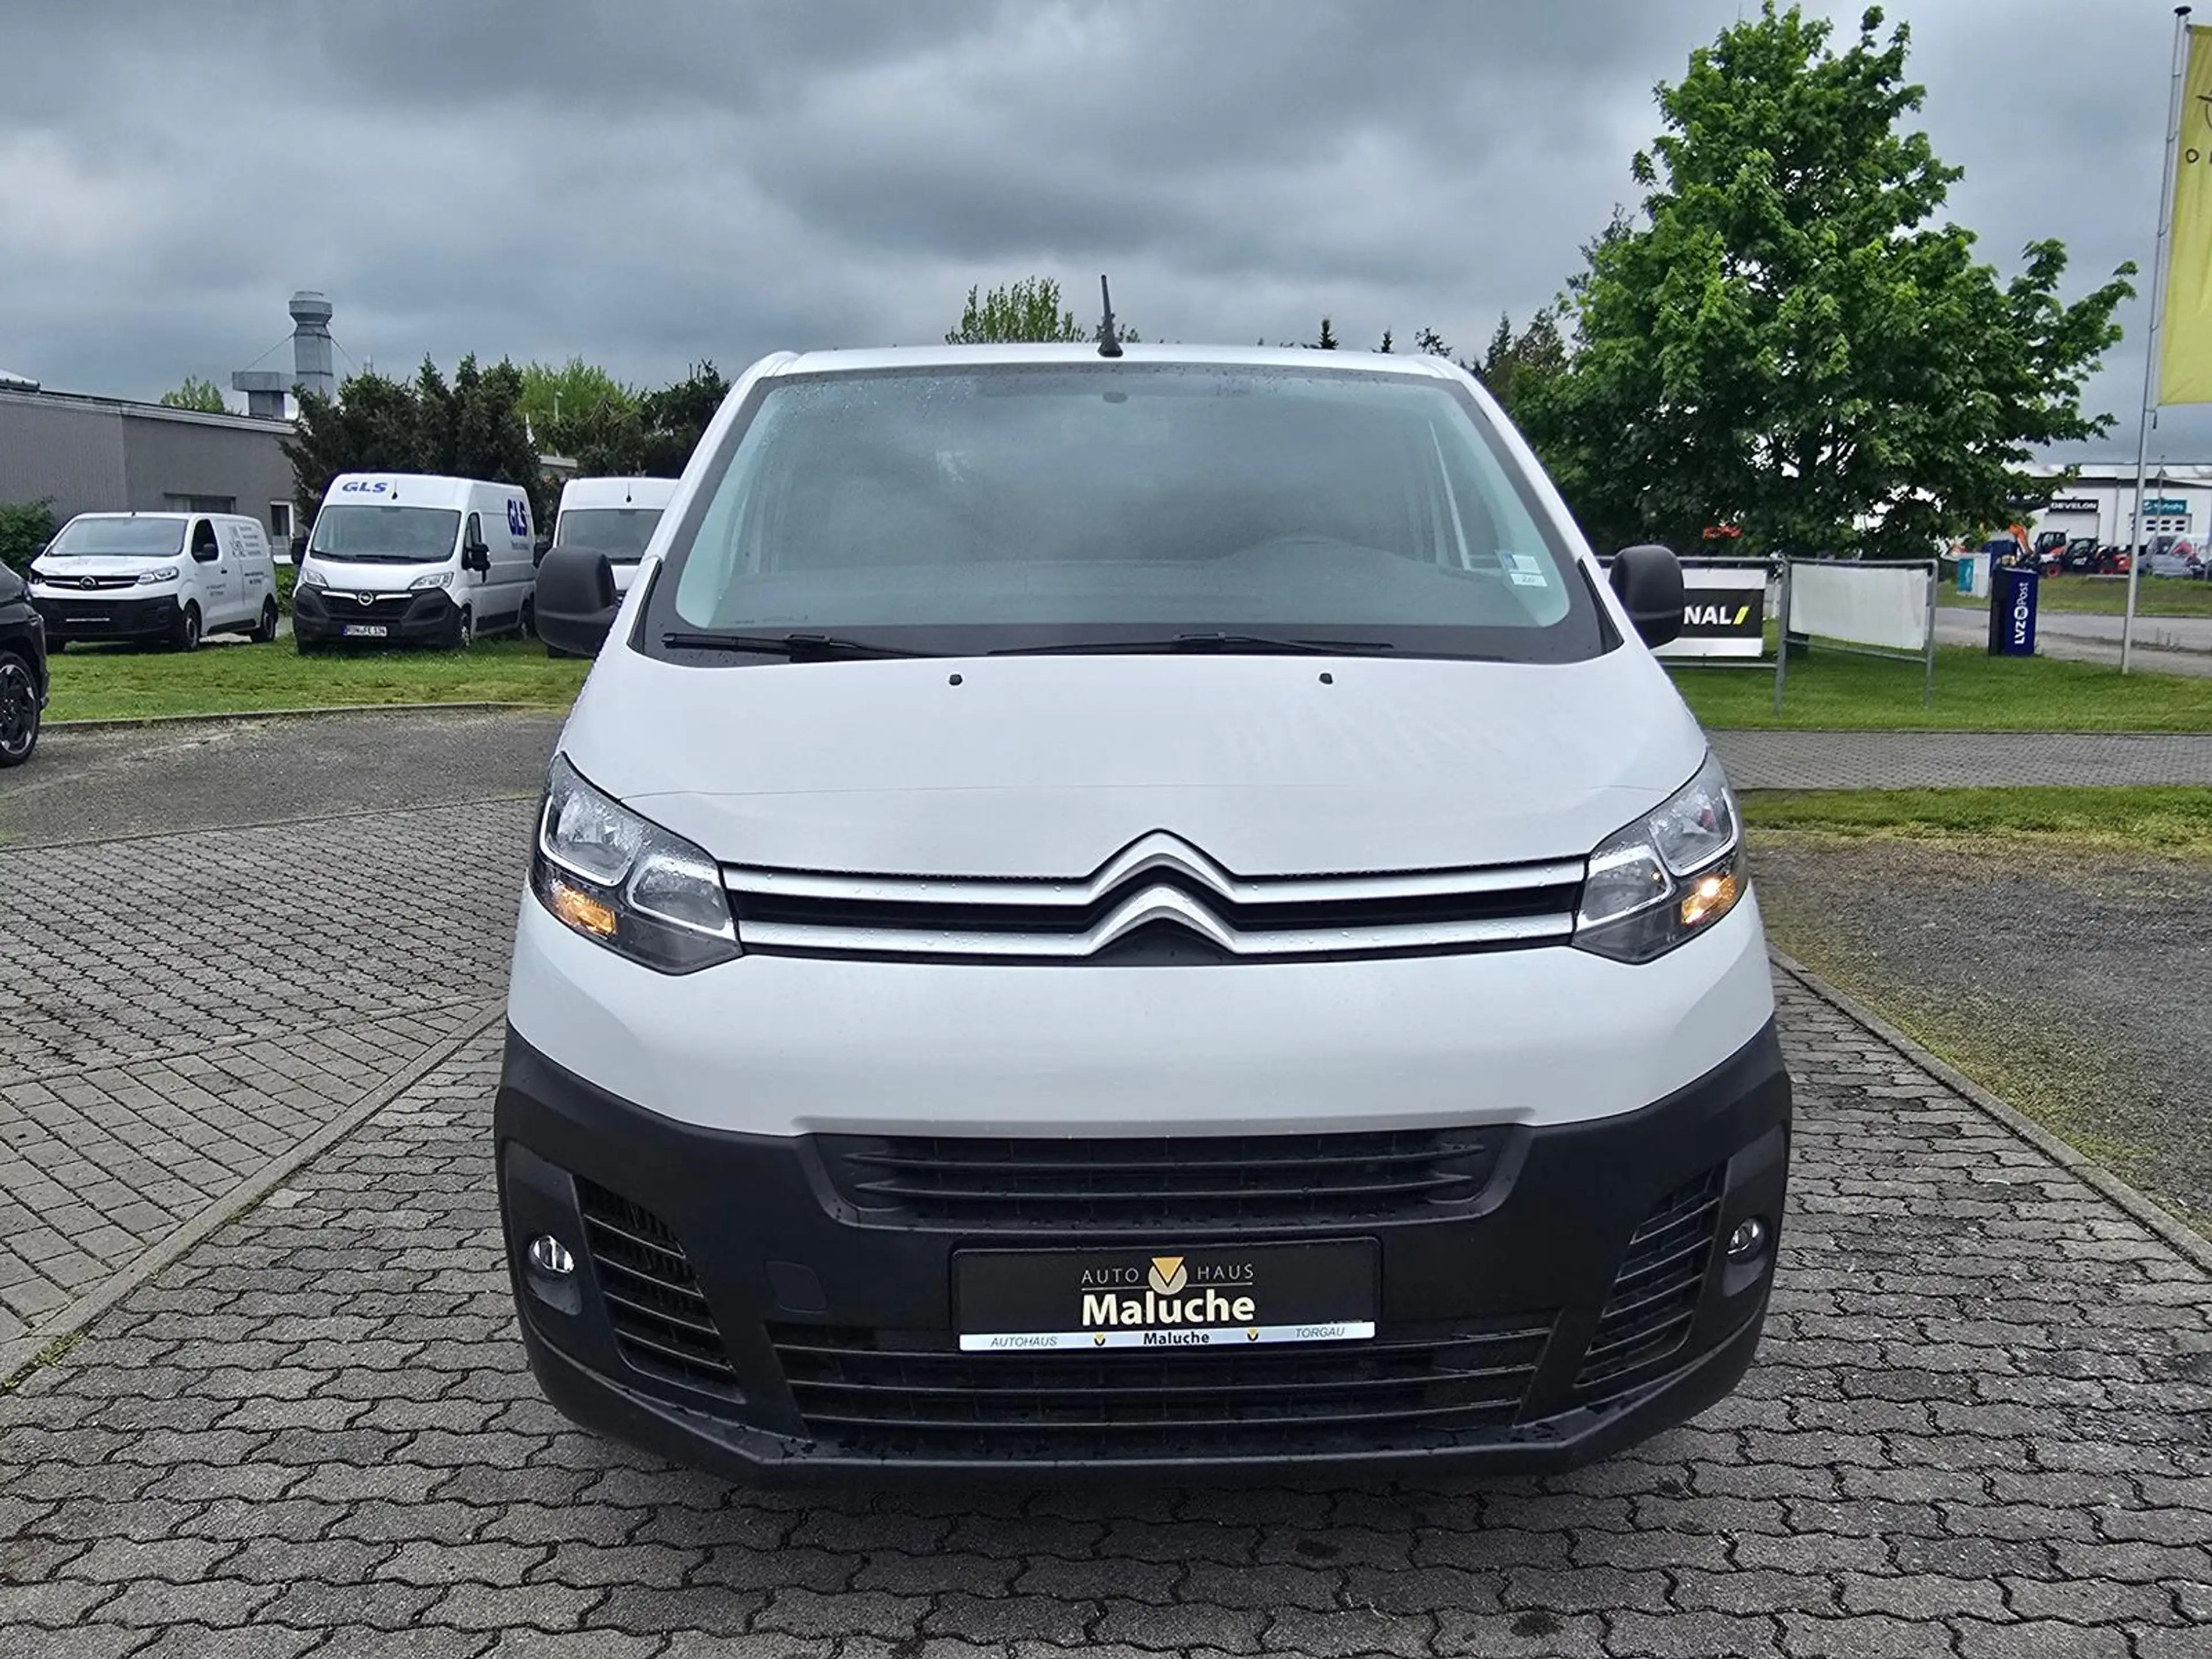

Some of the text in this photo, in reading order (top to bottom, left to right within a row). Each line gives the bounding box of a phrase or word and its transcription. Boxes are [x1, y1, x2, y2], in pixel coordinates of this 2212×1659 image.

[342, 482, 388, 493] GLS
[2050, 502, 2097, 510] DEVELON
[507, 499, 528, 536] GLS
[1683, 605, 1732, 625] NAL
[2014, 582, 2029, 644] LVZ Post
[1081, 1263, 1254, 1284] AUTO HAUS
[1082, 1288, 1256, 1327] Maluche
[989, 1327, 1346, 1348] AUTOHAUS Maluche TORGAU
